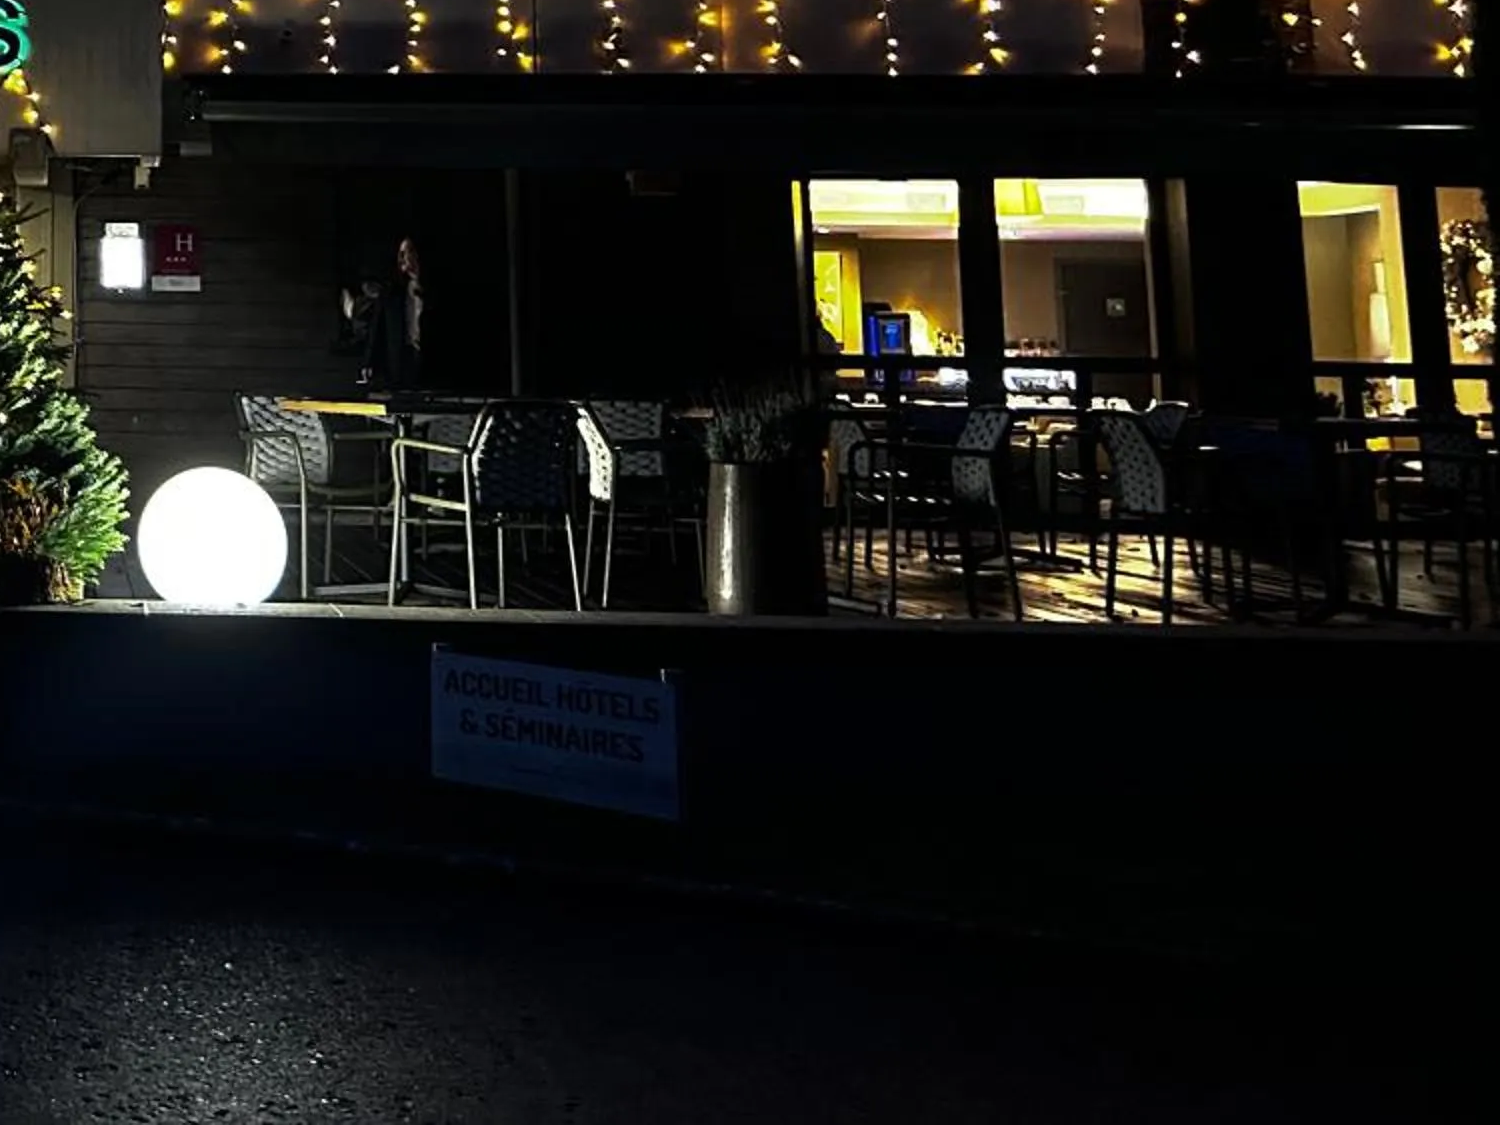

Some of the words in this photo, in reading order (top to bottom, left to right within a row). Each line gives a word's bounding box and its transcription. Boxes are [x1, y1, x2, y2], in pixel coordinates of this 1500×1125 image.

[175, 232, 193, 252] H
[444, 668, 550, 708] ACCUEIL
[556, 679, 660, 724] HÔTELS
[460, 708, 481, 736] &
[484, 707, 645, 763] SÉMINAIRES
